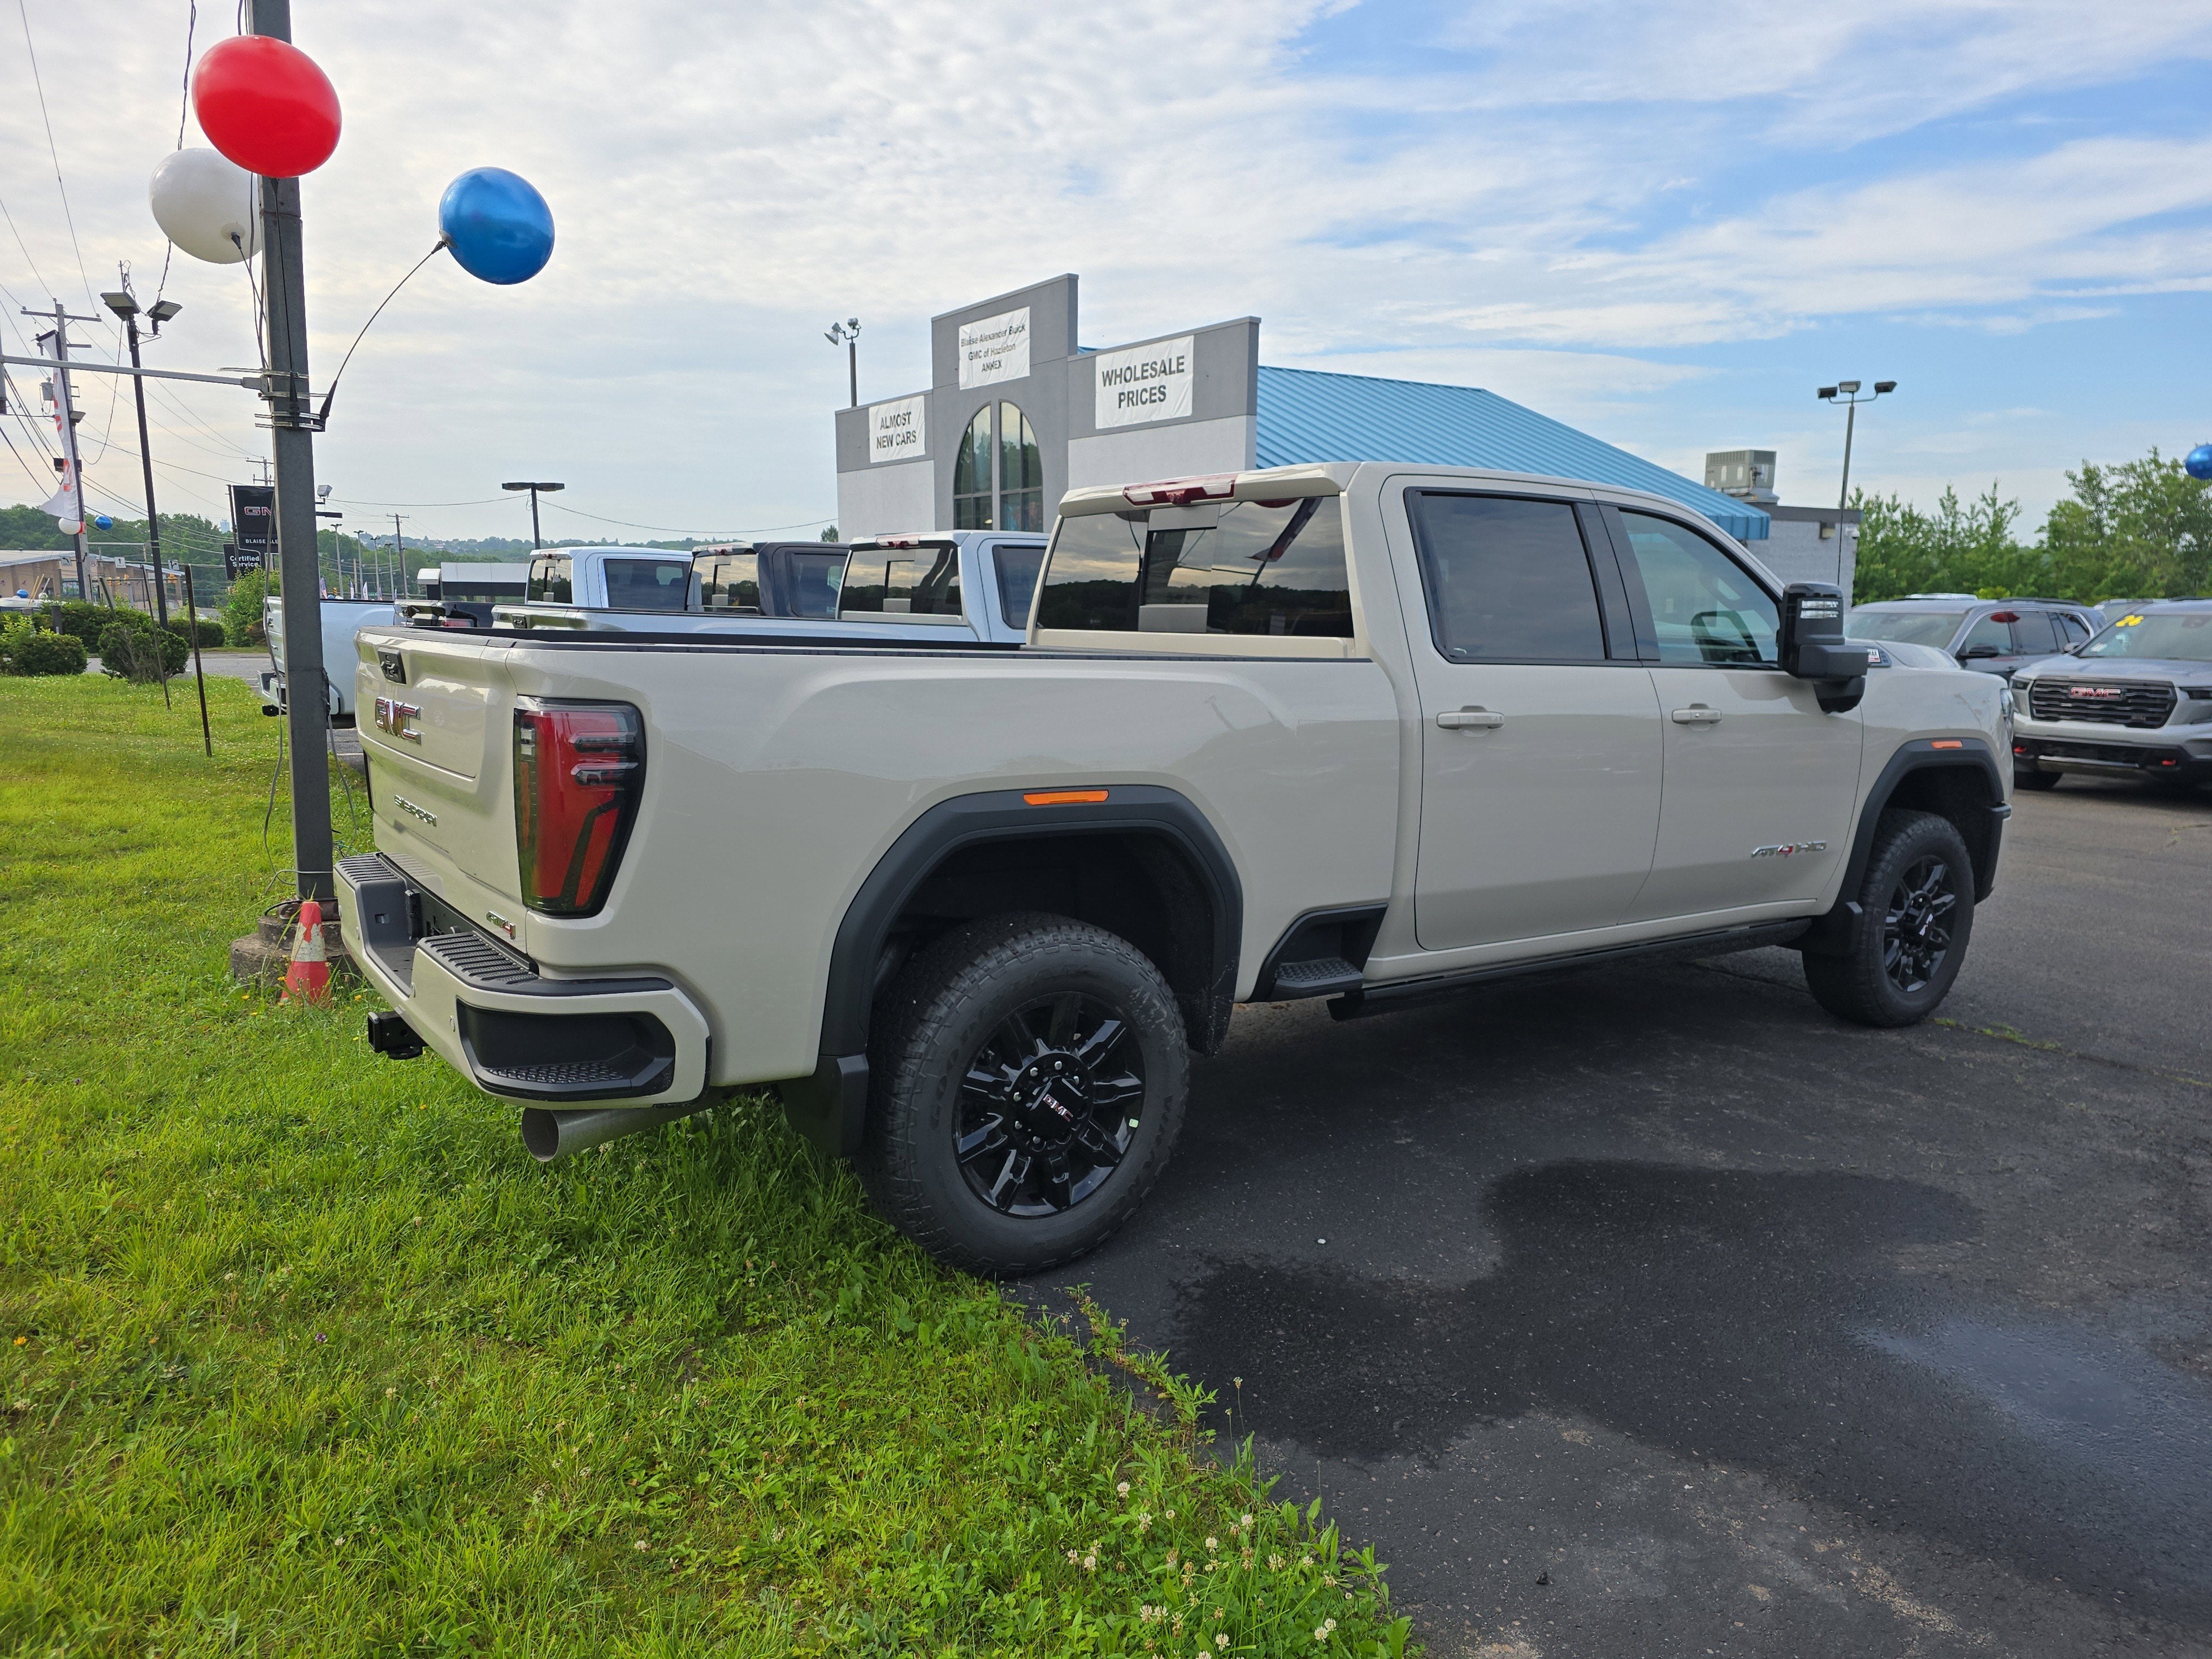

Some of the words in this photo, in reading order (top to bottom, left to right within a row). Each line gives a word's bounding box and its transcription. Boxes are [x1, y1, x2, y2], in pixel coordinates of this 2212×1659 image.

[961, 336, 978, 347] Blaise
[979, 330, 1007, 343] Alexander
[1009, 324, 1025, 335] Buick
[968, 350, 982, 361] GMC
[983, 348, 989, 357] of
[991, 343, 1016, 356] Hazleton
[981, 359, 1002, 372] ANNEX
[1102, 355, 1185, 387] WHOLESALE
[1118, 385, 1166, 409] PRICES
[880, 411, 911, 430] ALMOST
[877, 434, 893, 449] NEW
[896, 430, 916, 446] CARS
[2070, 686, 2121, 699] GMC
[375, 696, 423, 745] GMC
[394, 794, 437, 827] SIERRA
[486, 910, 516, 940] AT4
[1043, 1094, 1073, 1122] GMC
